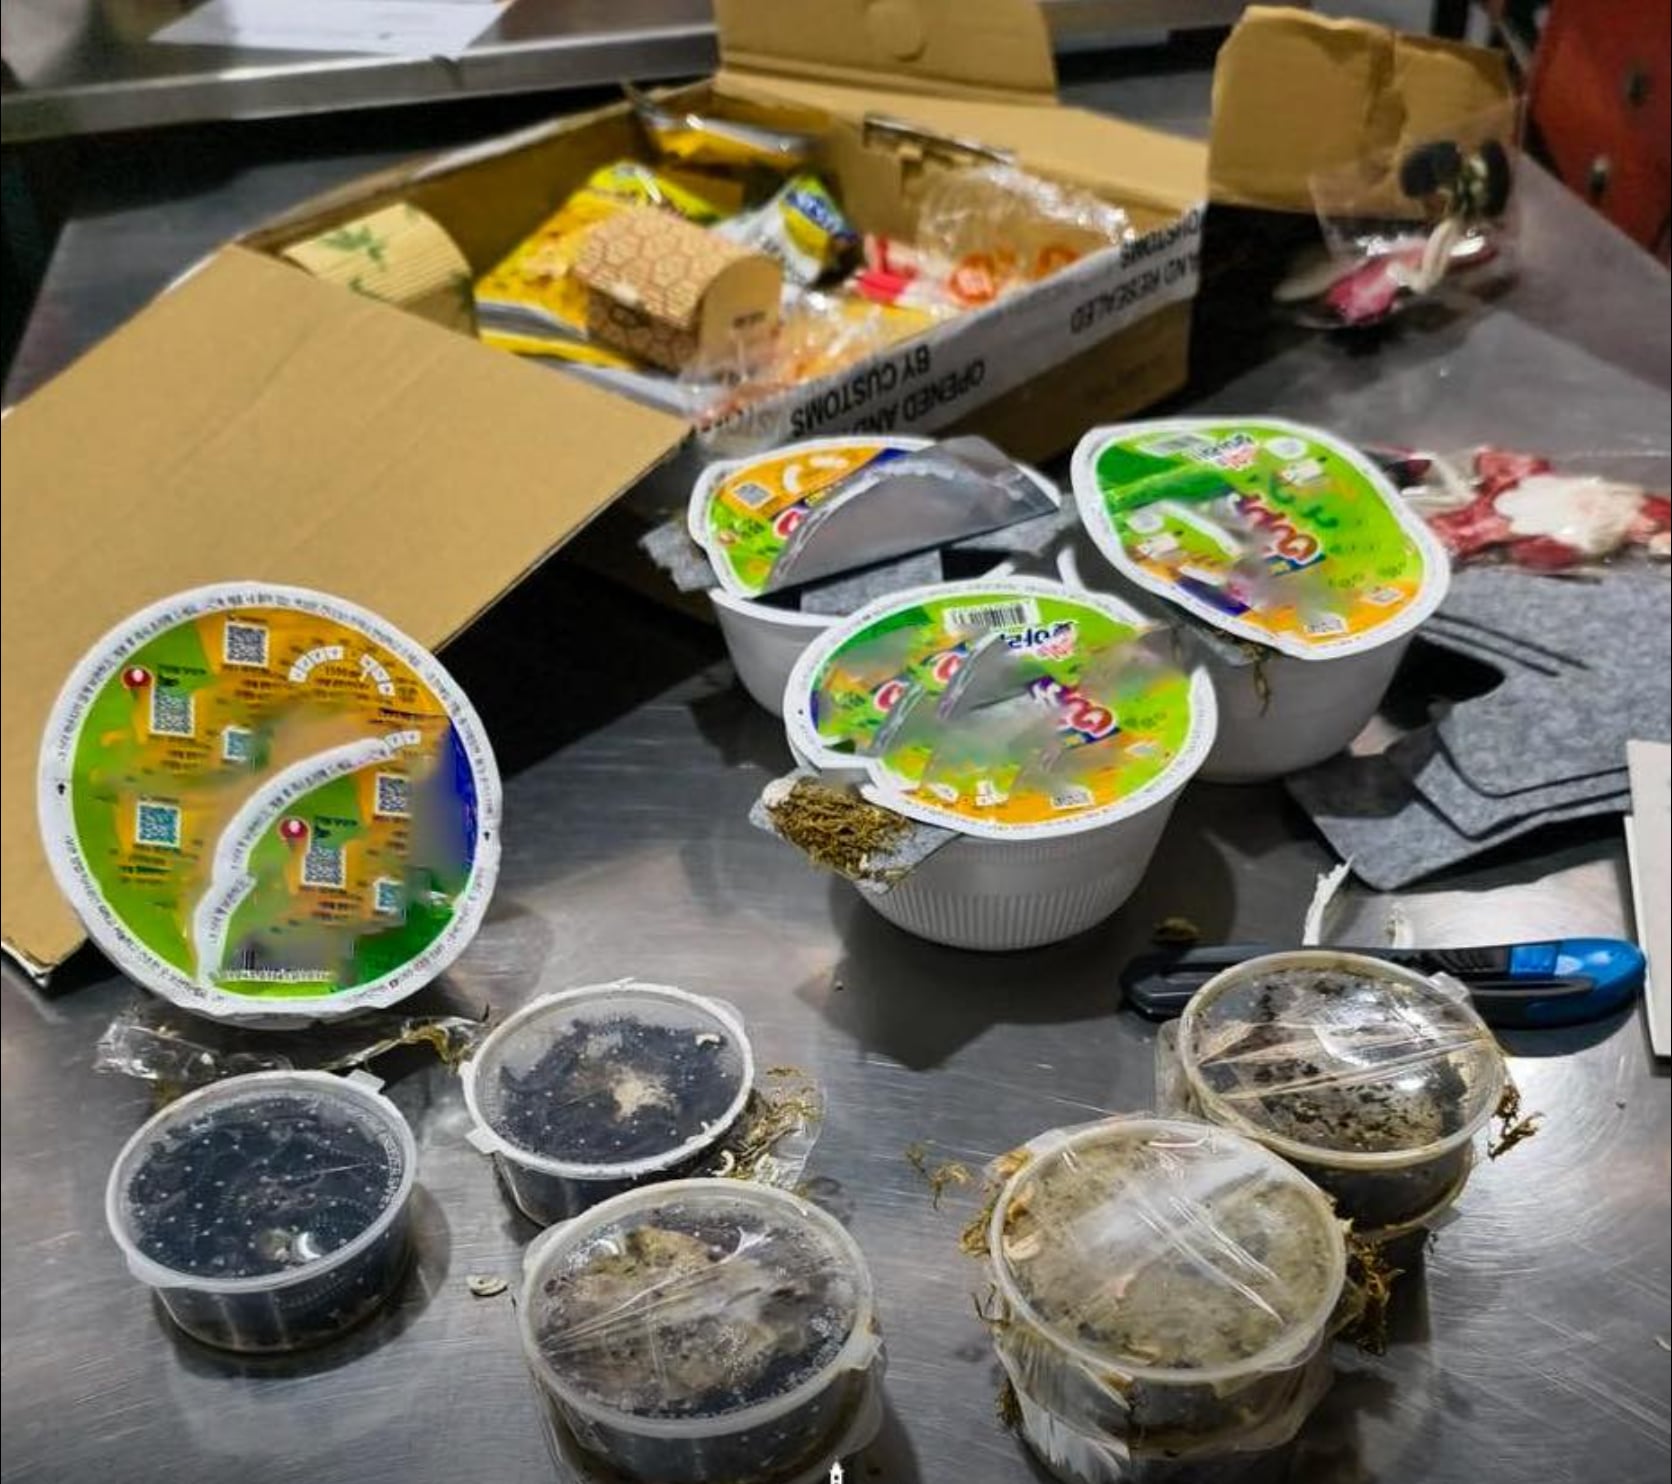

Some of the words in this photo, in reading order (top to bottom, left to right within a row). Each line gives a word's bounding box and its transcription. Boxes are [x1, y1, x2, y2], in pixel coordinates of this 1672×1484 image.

[1069, 269, 1161, 335] RESEALED
[900, 344, 932, 383] BY
[902, 359, 986, 424] OPENED
[789, 362, 898, 438] CUSTOMS
